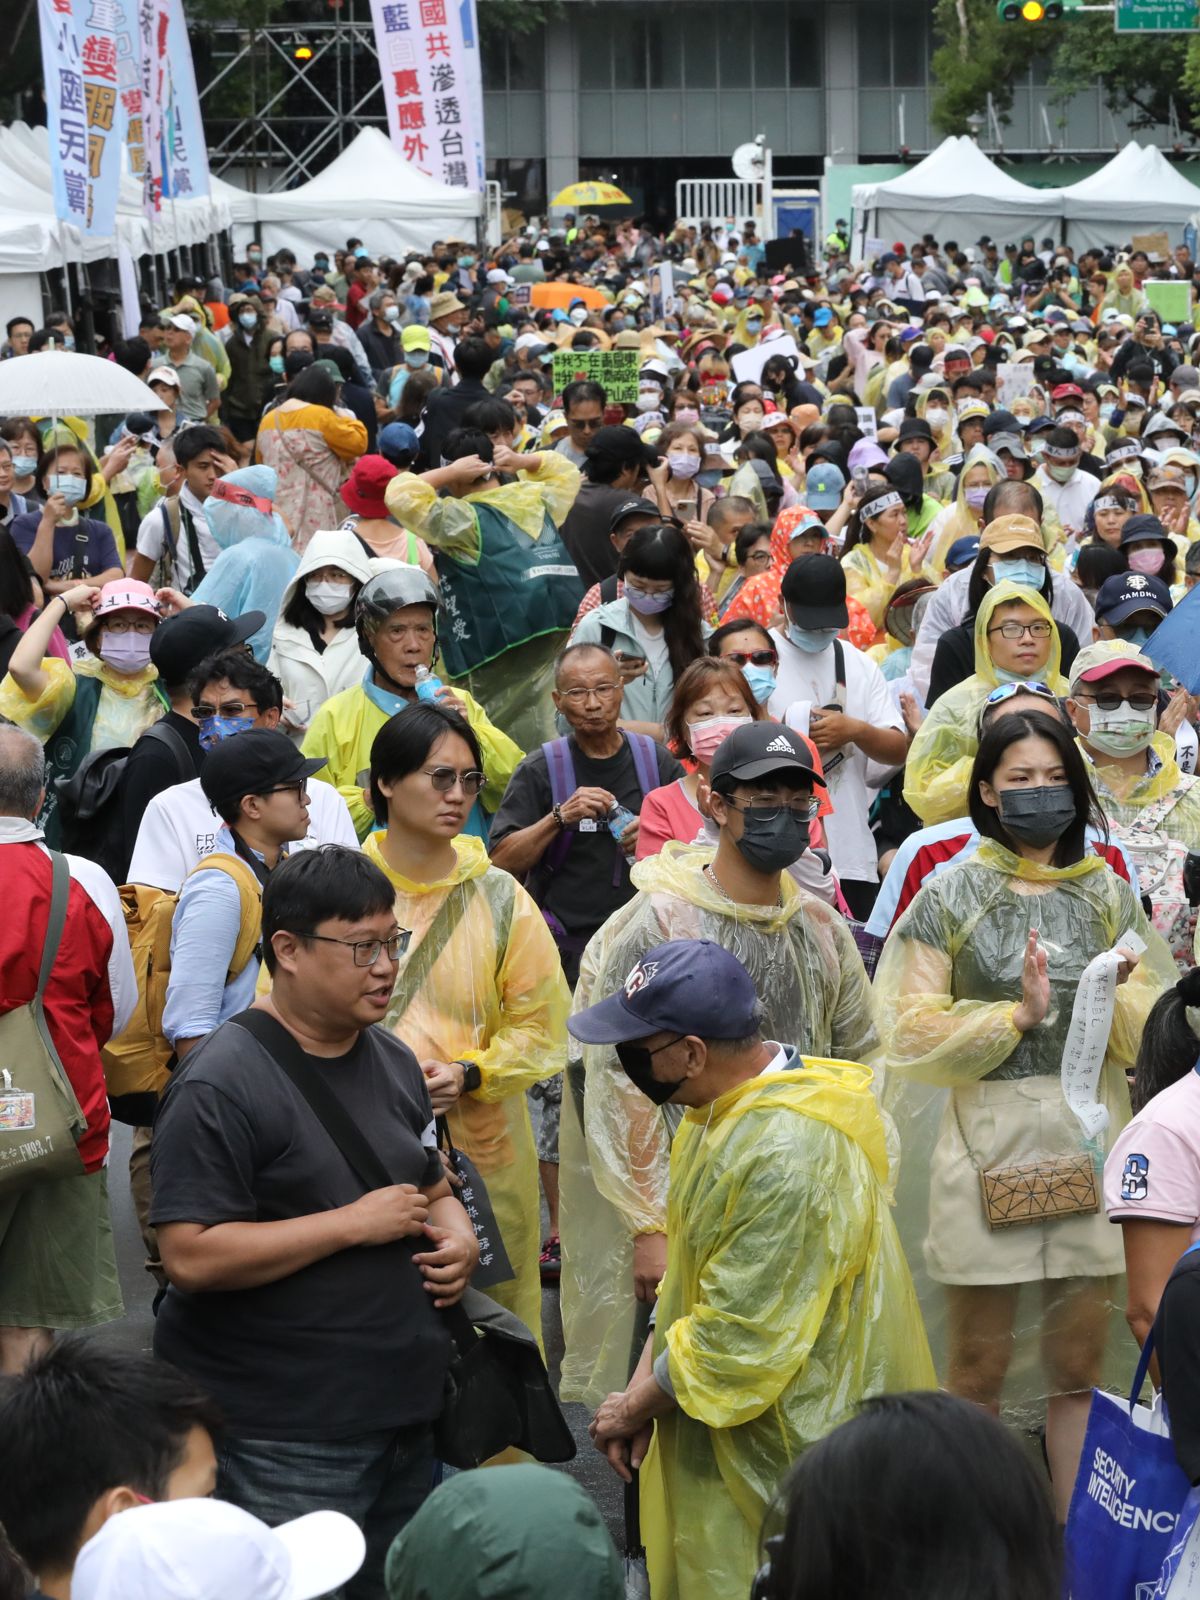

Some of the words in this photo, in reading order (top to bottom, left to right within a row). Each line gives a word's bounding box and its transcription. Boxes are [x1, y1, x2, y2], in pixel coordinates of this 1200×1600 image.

[382, 4, 432, 176] 藍白裏應外
[766, 745, 796, 756] adidas
[1121, 1153, 1149, 1200] 8
